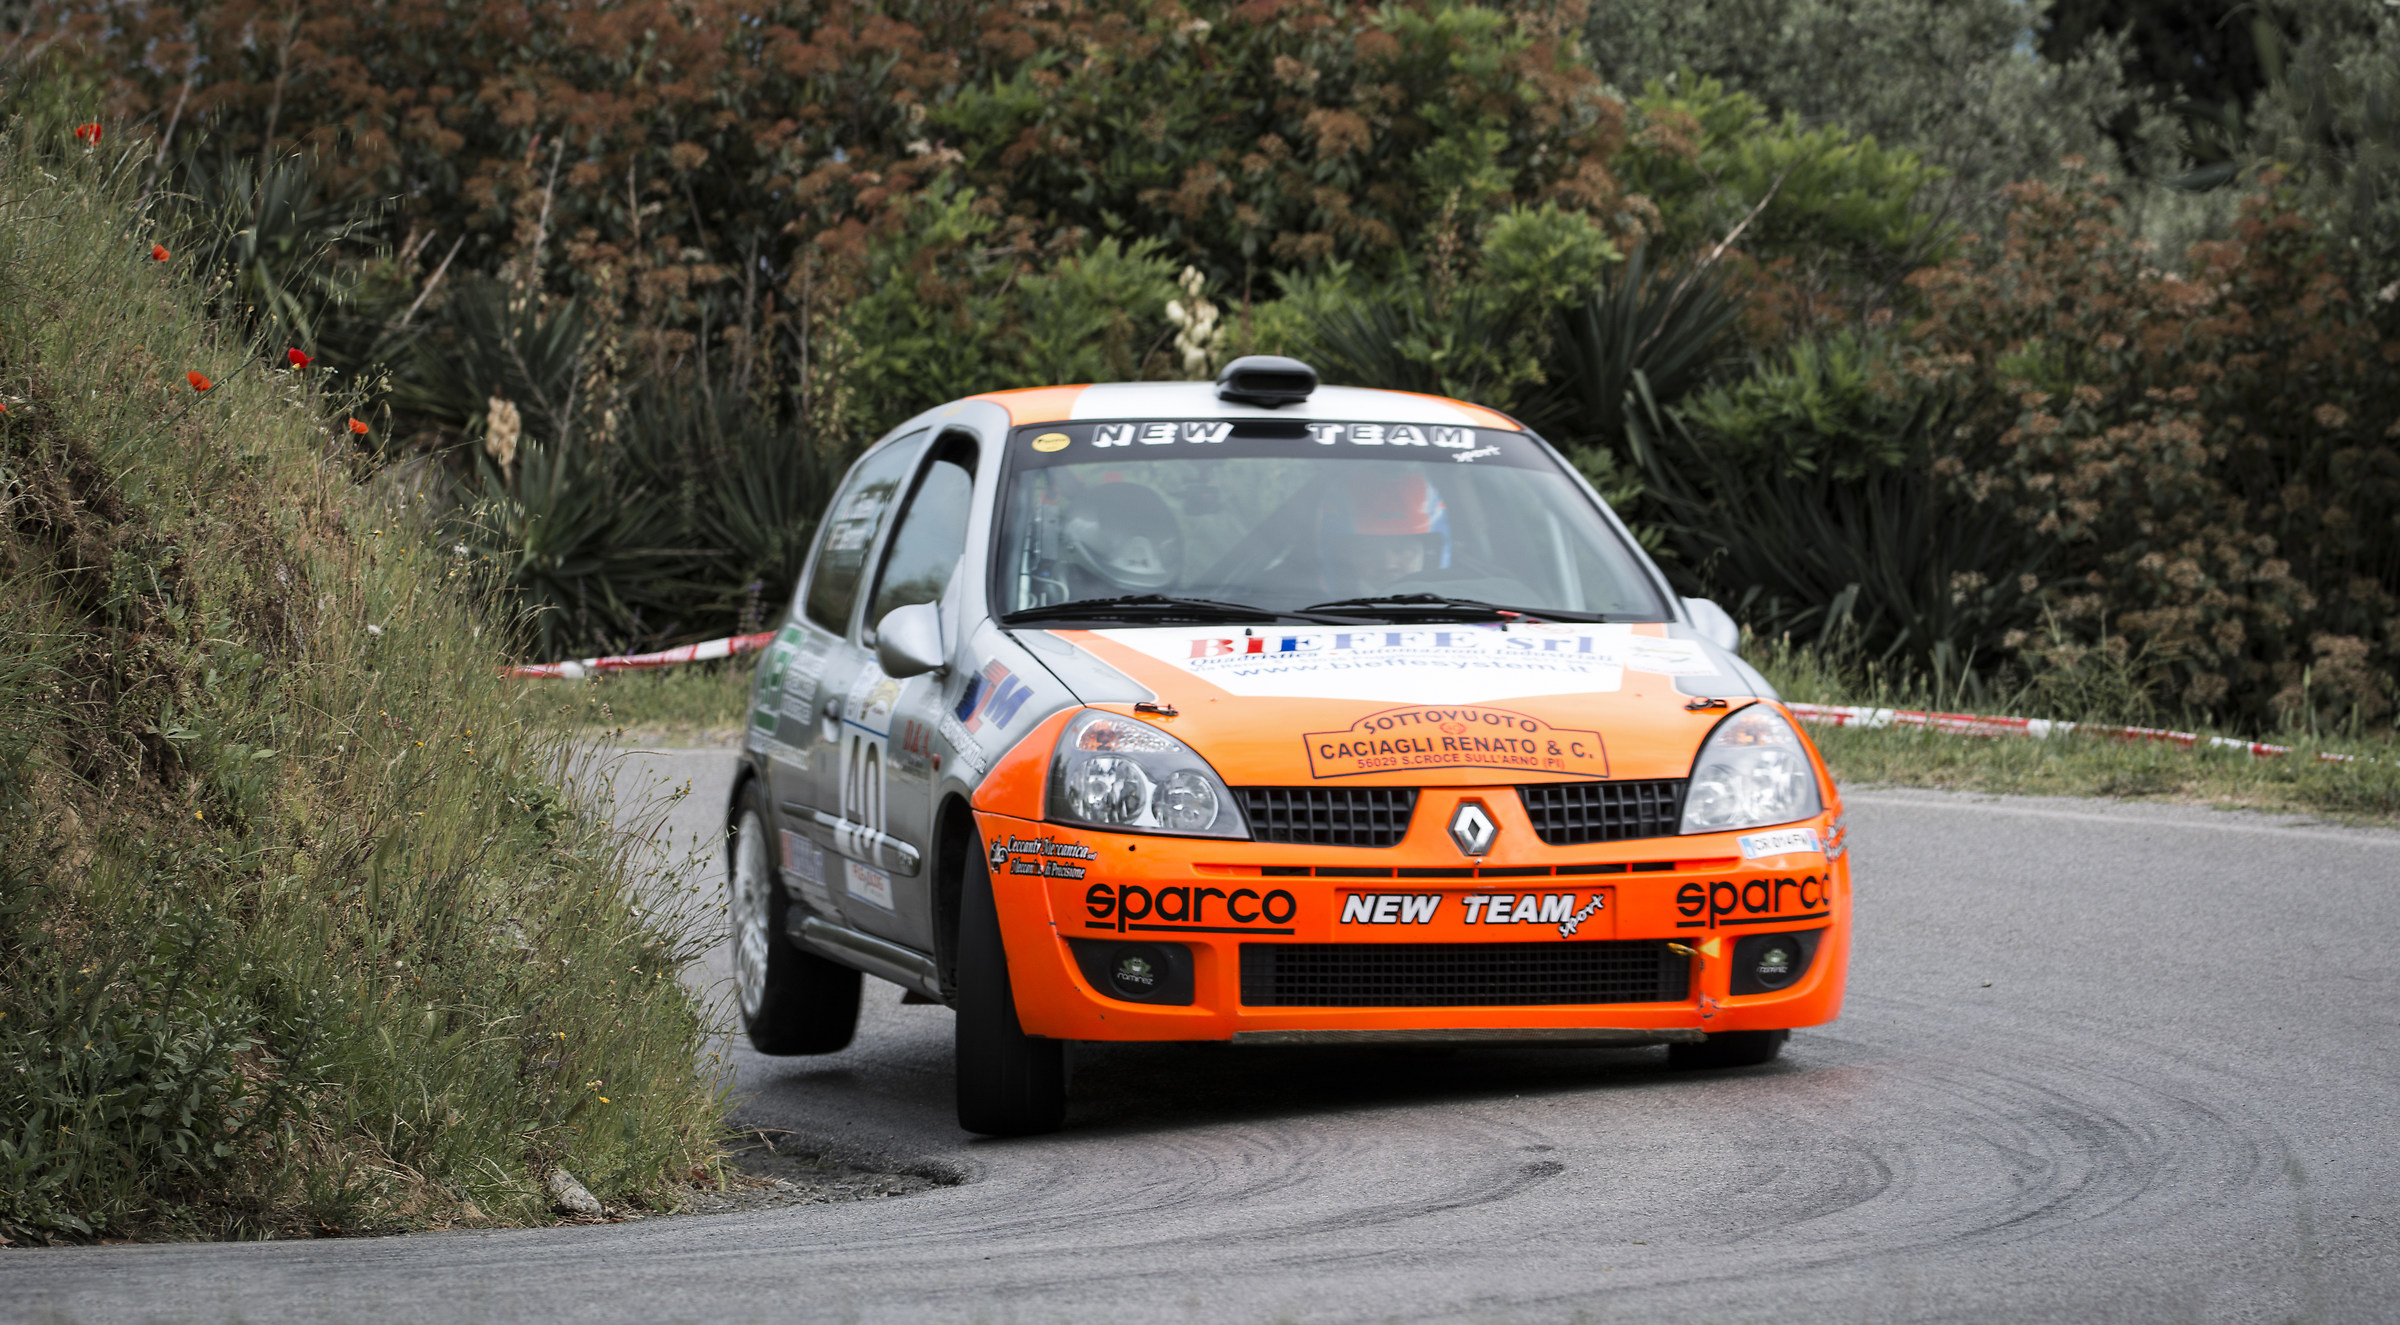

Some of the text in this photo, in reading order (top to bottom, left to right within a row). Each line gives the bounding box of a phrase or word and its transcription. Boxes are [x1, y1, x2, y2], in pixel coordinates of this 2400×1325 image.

[1091, 422, 1235, 448] NEW
[1305, 423, 1476, 449] TEAM
[1233, 659, 1591, 676] www.bieffesystem.it
[1363, 711, 1538, 735] SOTTOVUOTO
[1320, 736, 1593, 760] CACIAGLI RENATO & C.
[1357, 753, 1565, 770] 56029 S.CROCE SULL'ARNO (PI)
[846, 734, 883, 864] 40
[1085, 883, 1297, 934] sparco
[1340, 893, 1576, 924] NEW TEAM
[1558, 893, 1604, 939] sport
